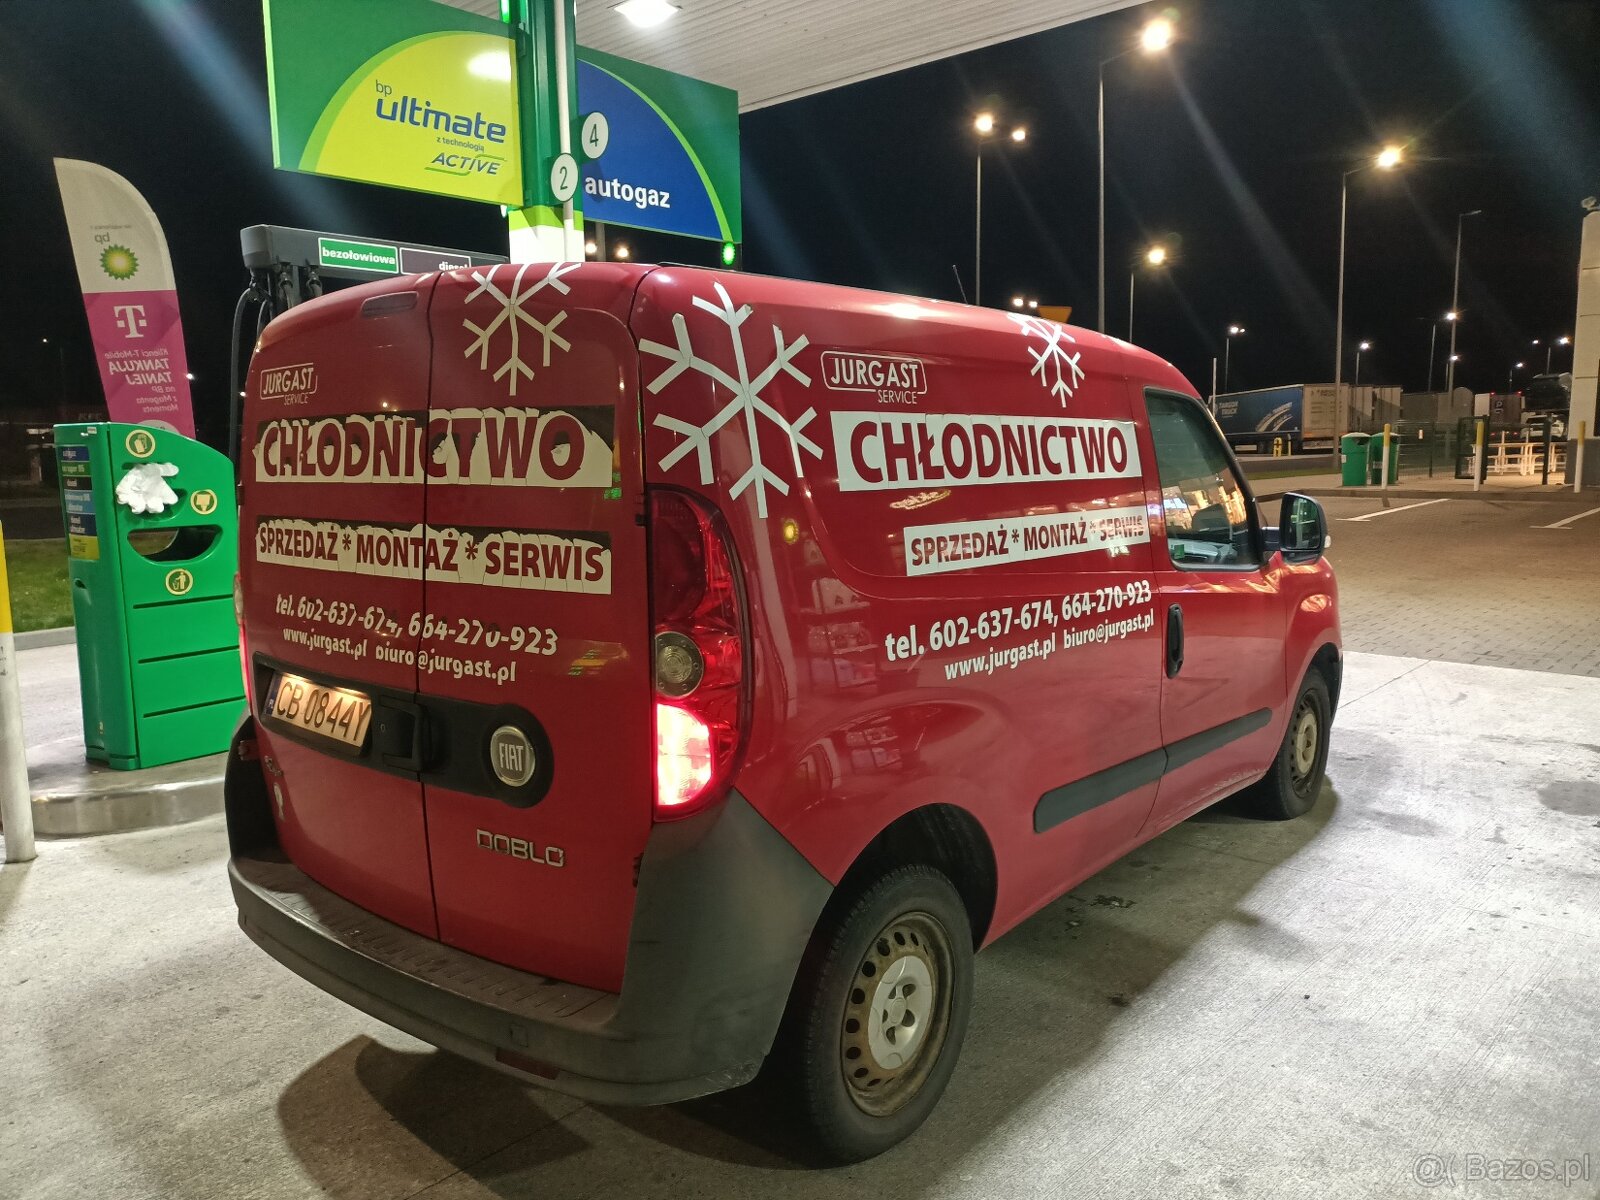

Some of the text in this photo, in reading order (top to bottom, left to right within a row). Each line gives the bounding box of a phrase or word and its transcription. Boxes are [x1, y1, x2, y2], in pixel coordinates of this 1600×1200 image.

[375, 79, 393, 97] bp
[376, 95, 507, 143] ultimate
[589, 123, 599, 147] 4
[431, 152, 500, 175] ACTIVE
[559, 166, 568, 190] 2
[585, 176, 671, 209] autogaz
[322, 246, 396, 265] bezołowiowa
[263, 367, 314, 395] JURGAST
[831, 357, 918, 388] JURGAST
[283, 393, 309, 406] SERVICE
[877, 389, 918, 405] SERVICE
[263, 415, 586, 481] CHŁODNICTWO
[850, 420, 1128, 483] CHŁODNICTWO
[259, 525, 604, 583] SPRZEDAŻ MONTAŻ SERWIS
[911, 523, 1009, 567] SPRZEDAŻ
[1023, 517, 1088, 552] MONTAŻ
[275, 593, 295, 617] tel.
[408, 612, 559, 656] 664-270-923
[885, 580, 1153, 662] tel. 602-637-674, 664-270-923
[283, 627, 368, 660] www.jurgast.pl
[944, 608, 1155, 680] www.jurgast.pl biuro@jurgast.pl
[277, 682, 371, 741] CB 0844Y
[499, 742, 524, 771] FIAT
[476, 828, 565, 868] DOBLO
